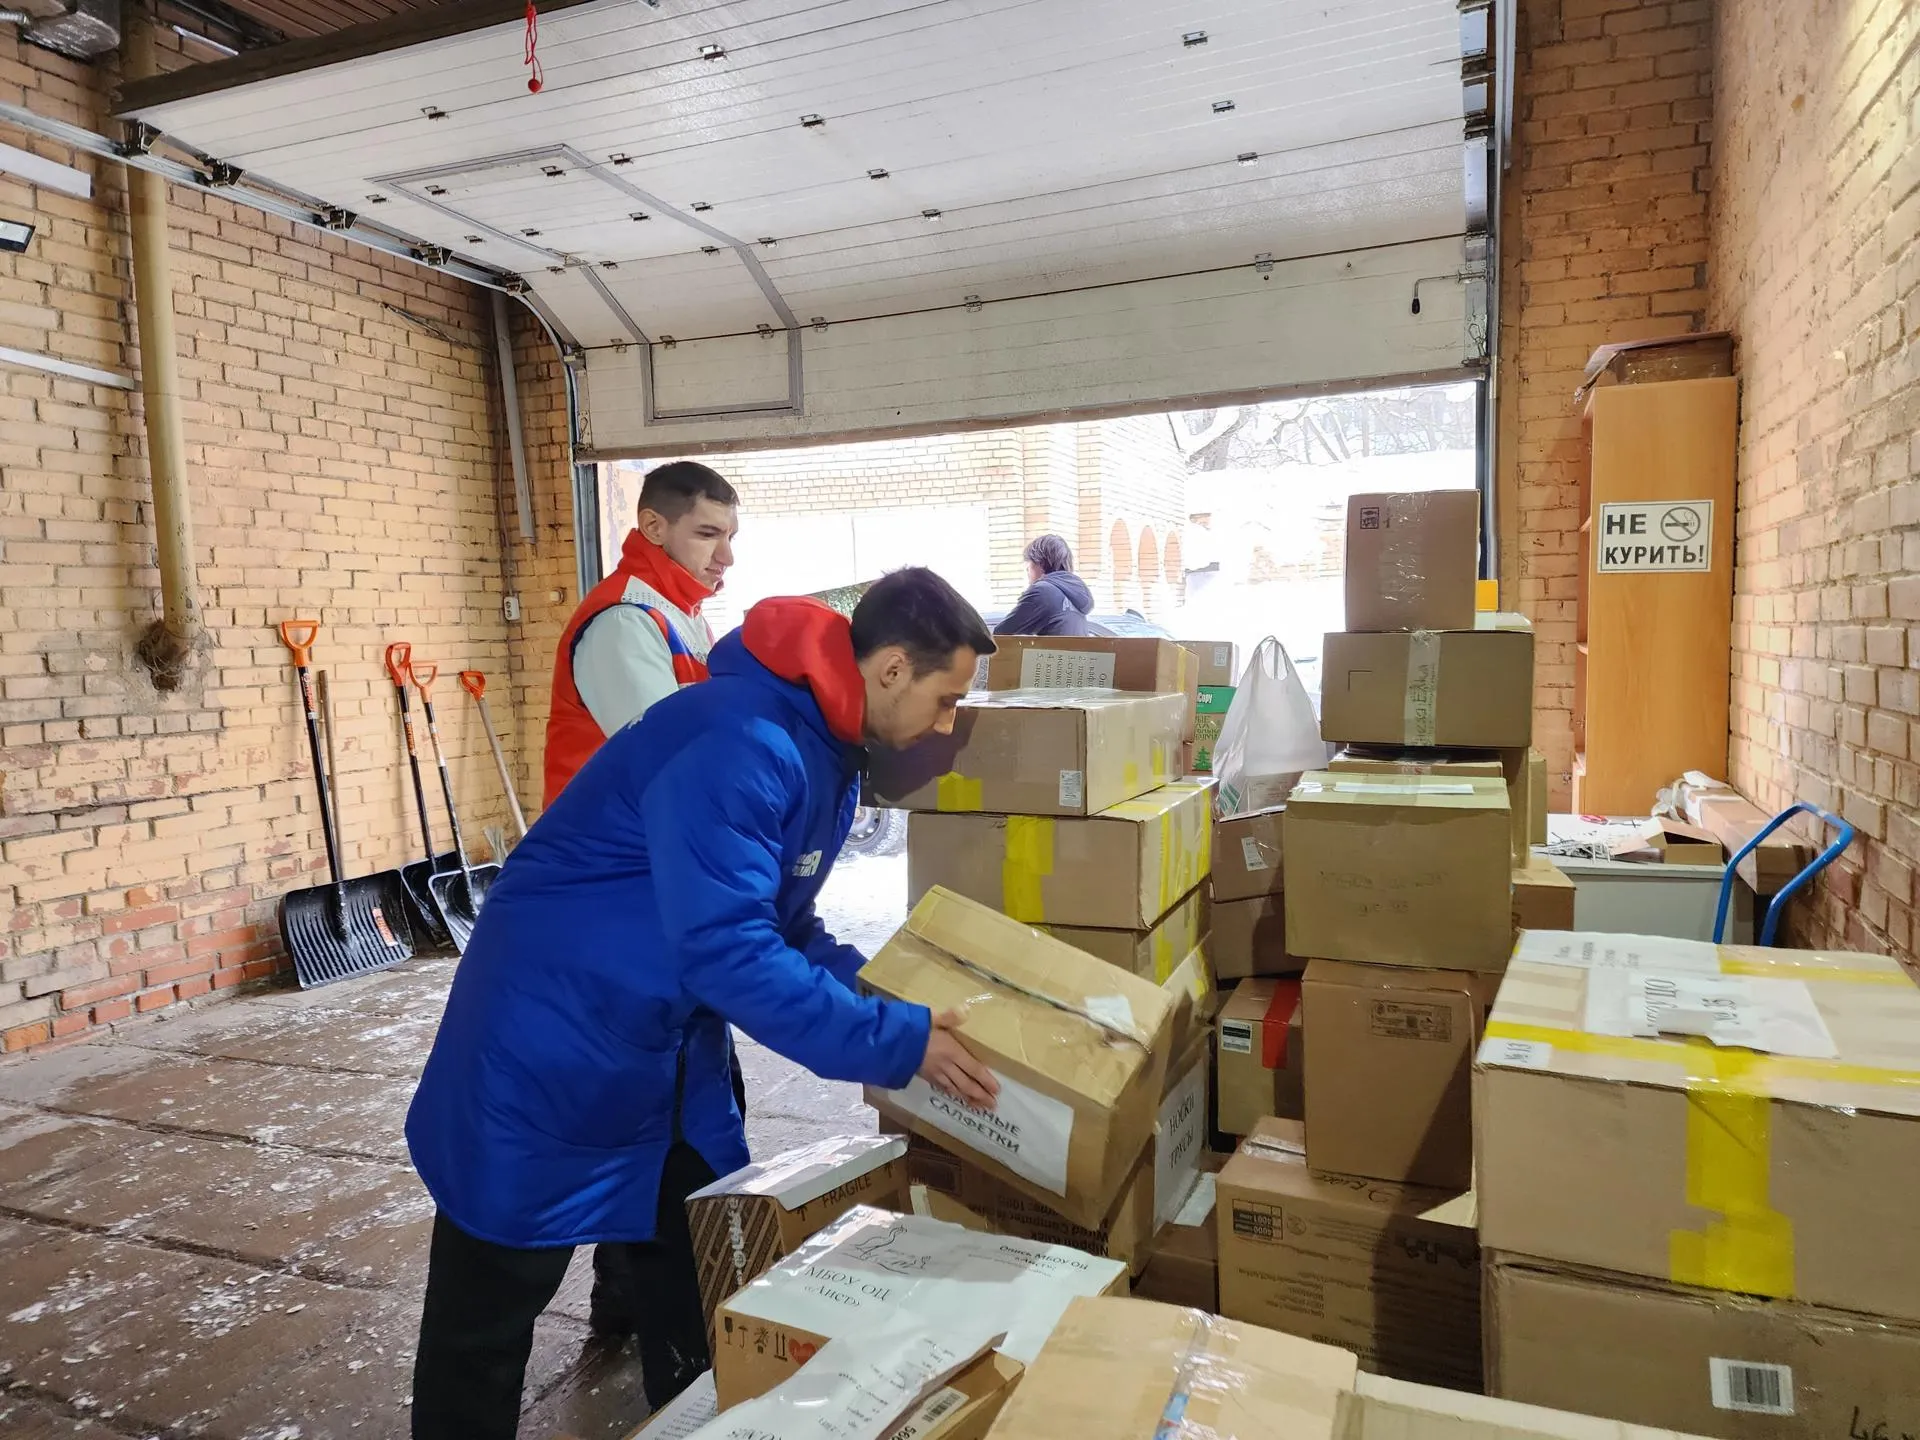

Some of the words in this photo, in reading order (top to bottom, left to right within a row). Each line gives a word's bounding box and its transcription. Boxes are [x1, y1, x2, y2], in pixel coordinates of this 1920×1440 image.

[1606, 513, 1647, 535] НЕ
[1605, 545, 1704, 565] КУРИТЬ!
[929, 1096, 1020, 1153] САЛФЕТКИ
[1169, 1092, 1194, 1136] НОСКИ
[821, 1174, 872, 1208] FRAGILE
[804, 1265, 861, 1286] МБОУ
